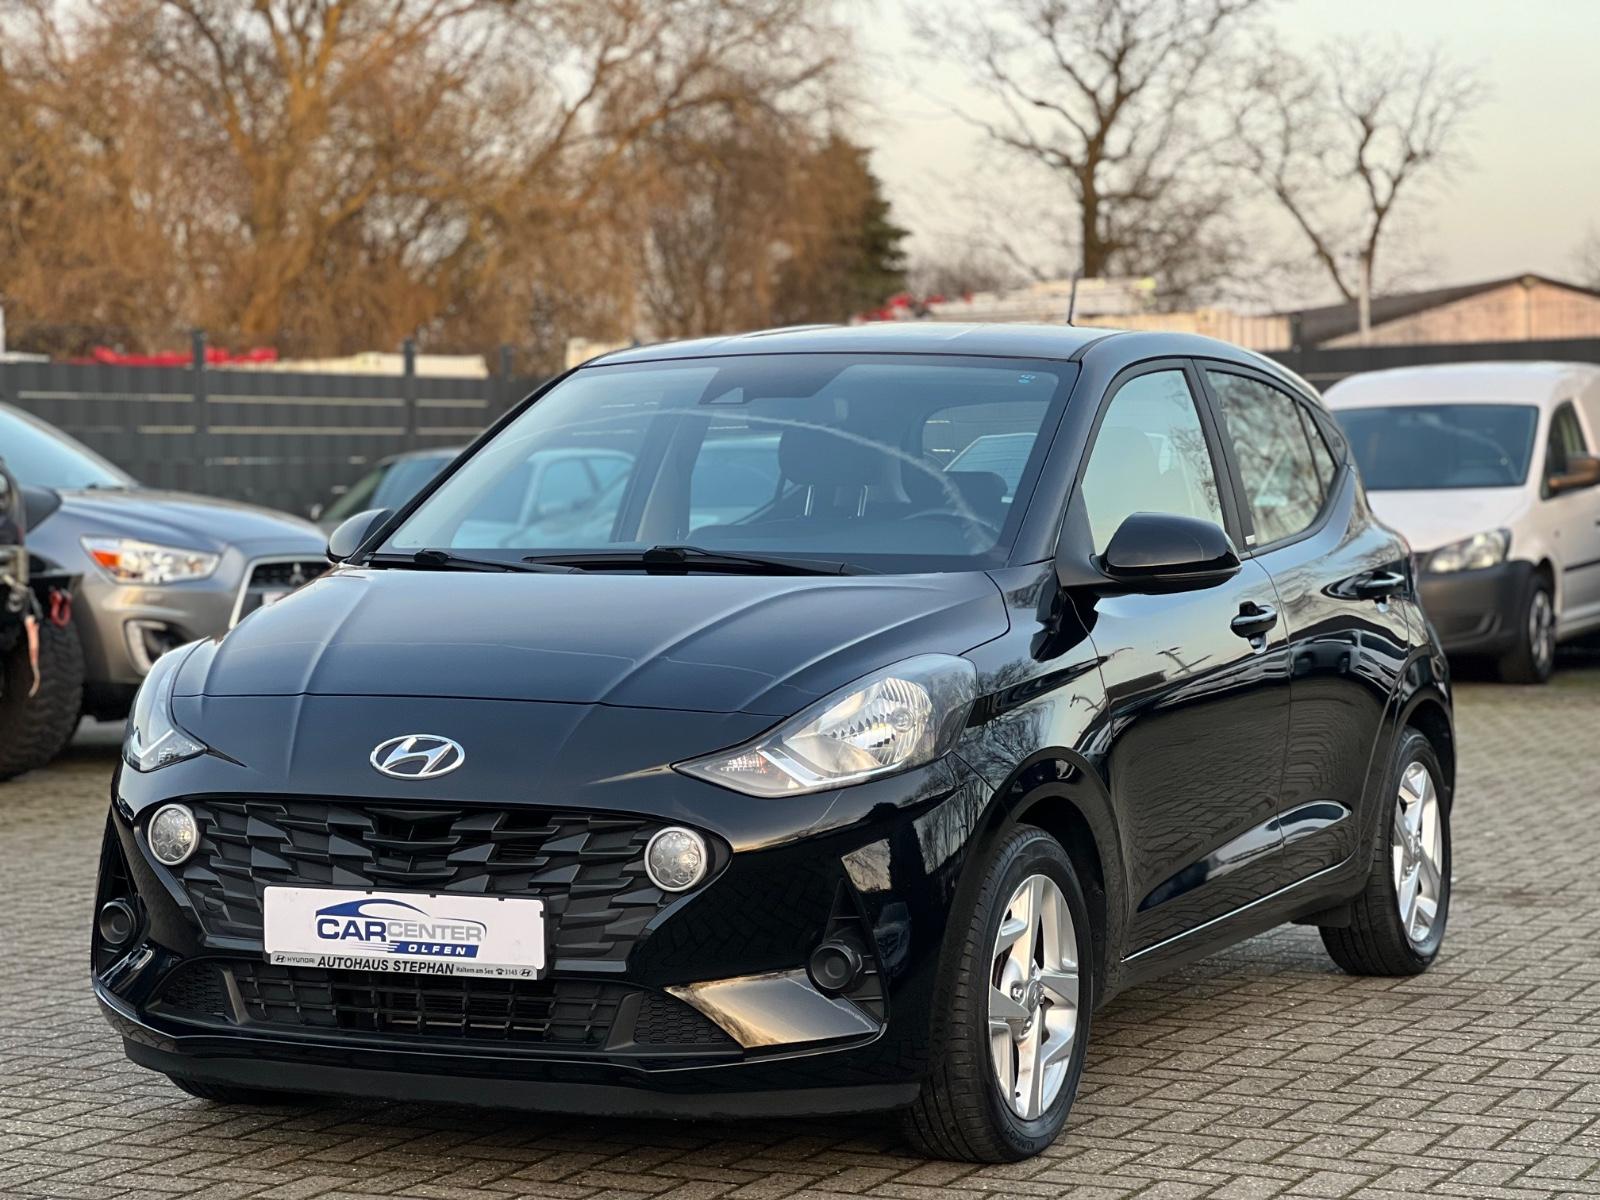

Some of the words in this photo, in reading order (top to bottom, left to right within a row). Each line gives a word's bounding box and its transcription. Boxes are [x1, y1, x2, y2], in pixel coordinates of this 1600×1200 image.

[408, 944, 466, 955] OLFEN
[317, 955, 389, 971] AUTOHAUS
[393, 960, 455, 975] STEPHAN
